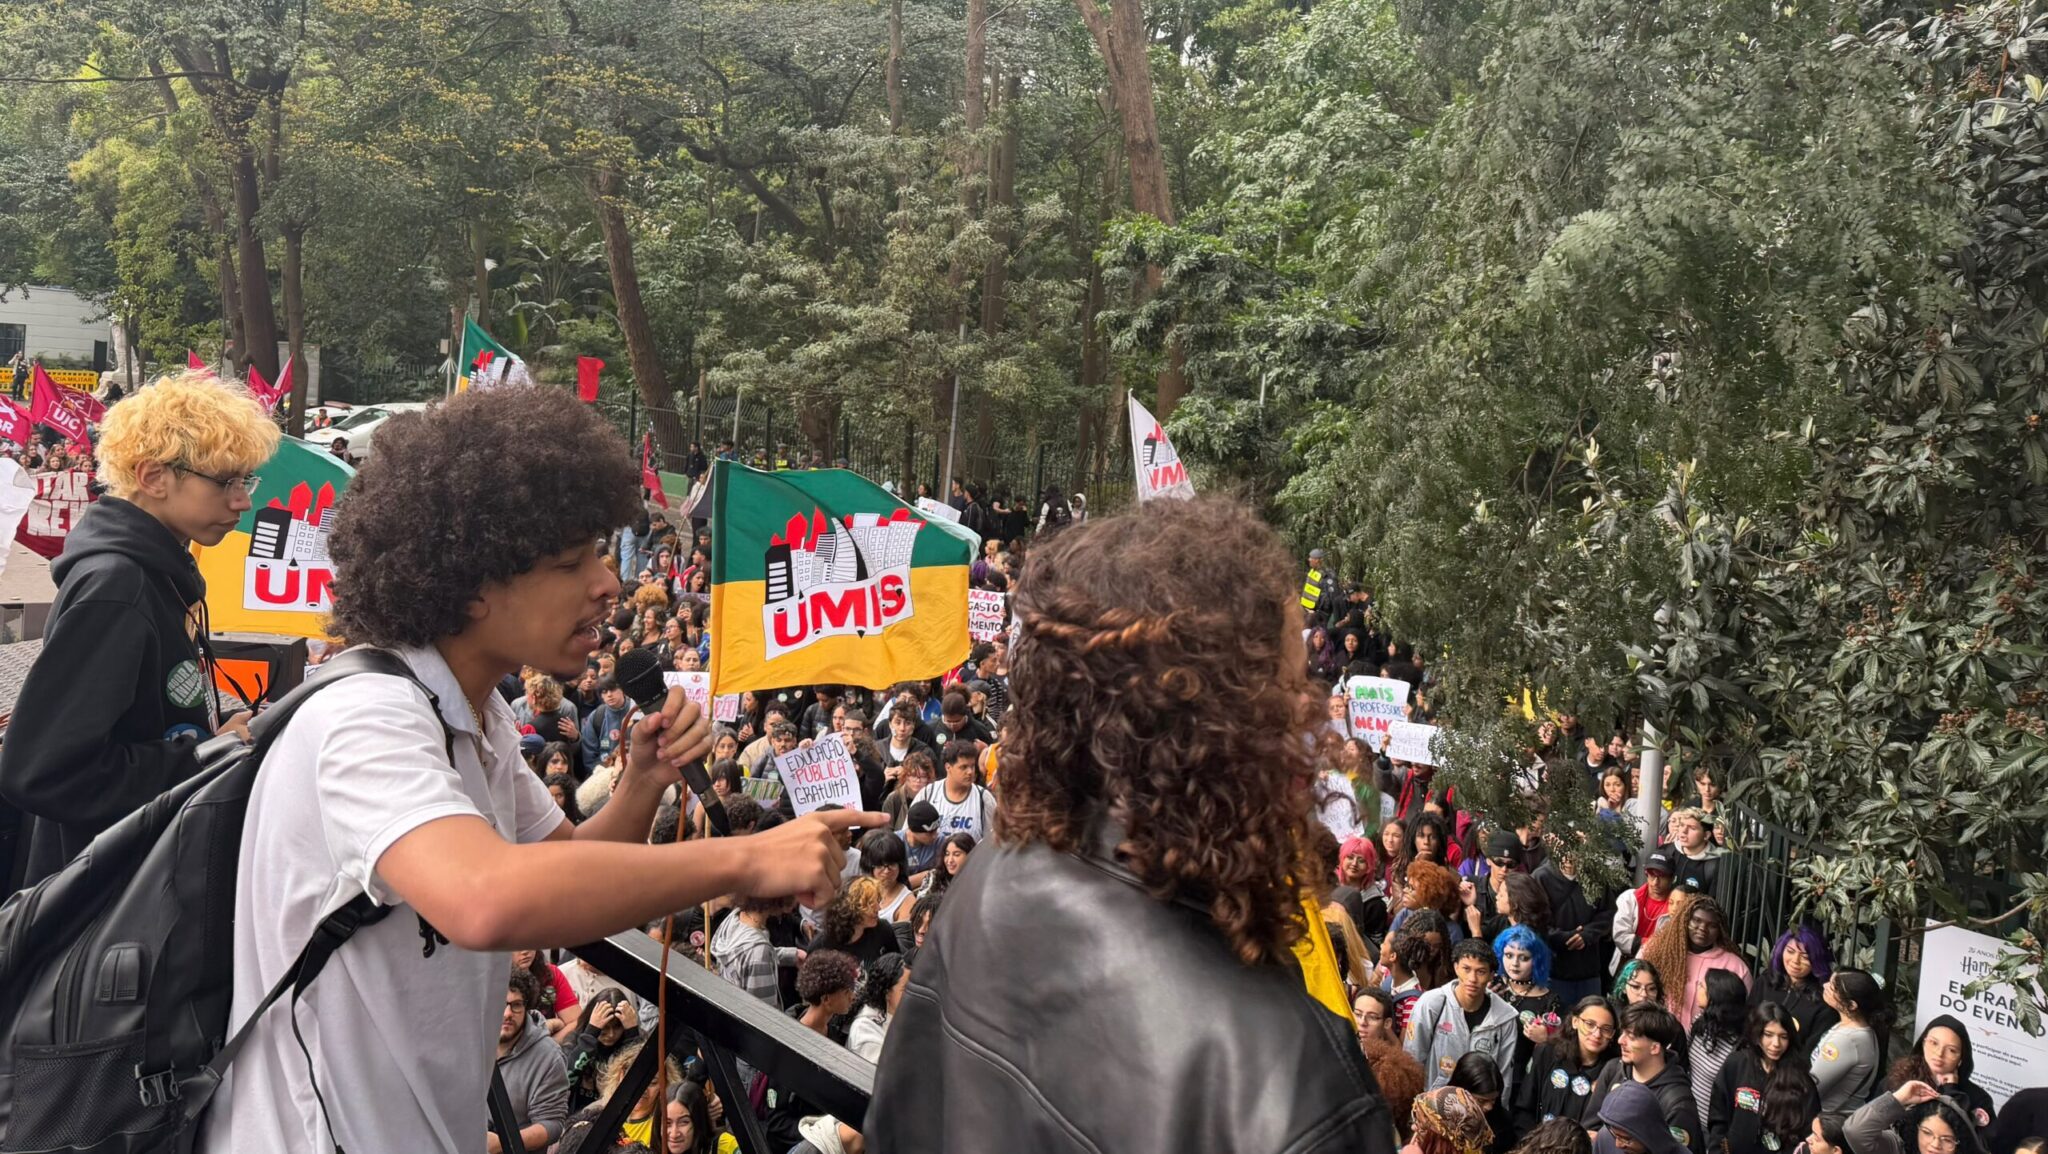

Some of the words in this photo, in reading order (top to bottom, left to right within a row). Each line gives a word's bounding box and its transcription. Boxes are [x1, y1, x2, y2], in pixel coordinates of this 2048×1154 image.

[53, 408, 80, 431] UJC
[31, 471, 89, 501] TAR
[785, 737, 845, 773] EDUCAÇÃO
[1940, 994, 1967, 1013] DO
[1973, 1004, 2046, 1037] EVENO
